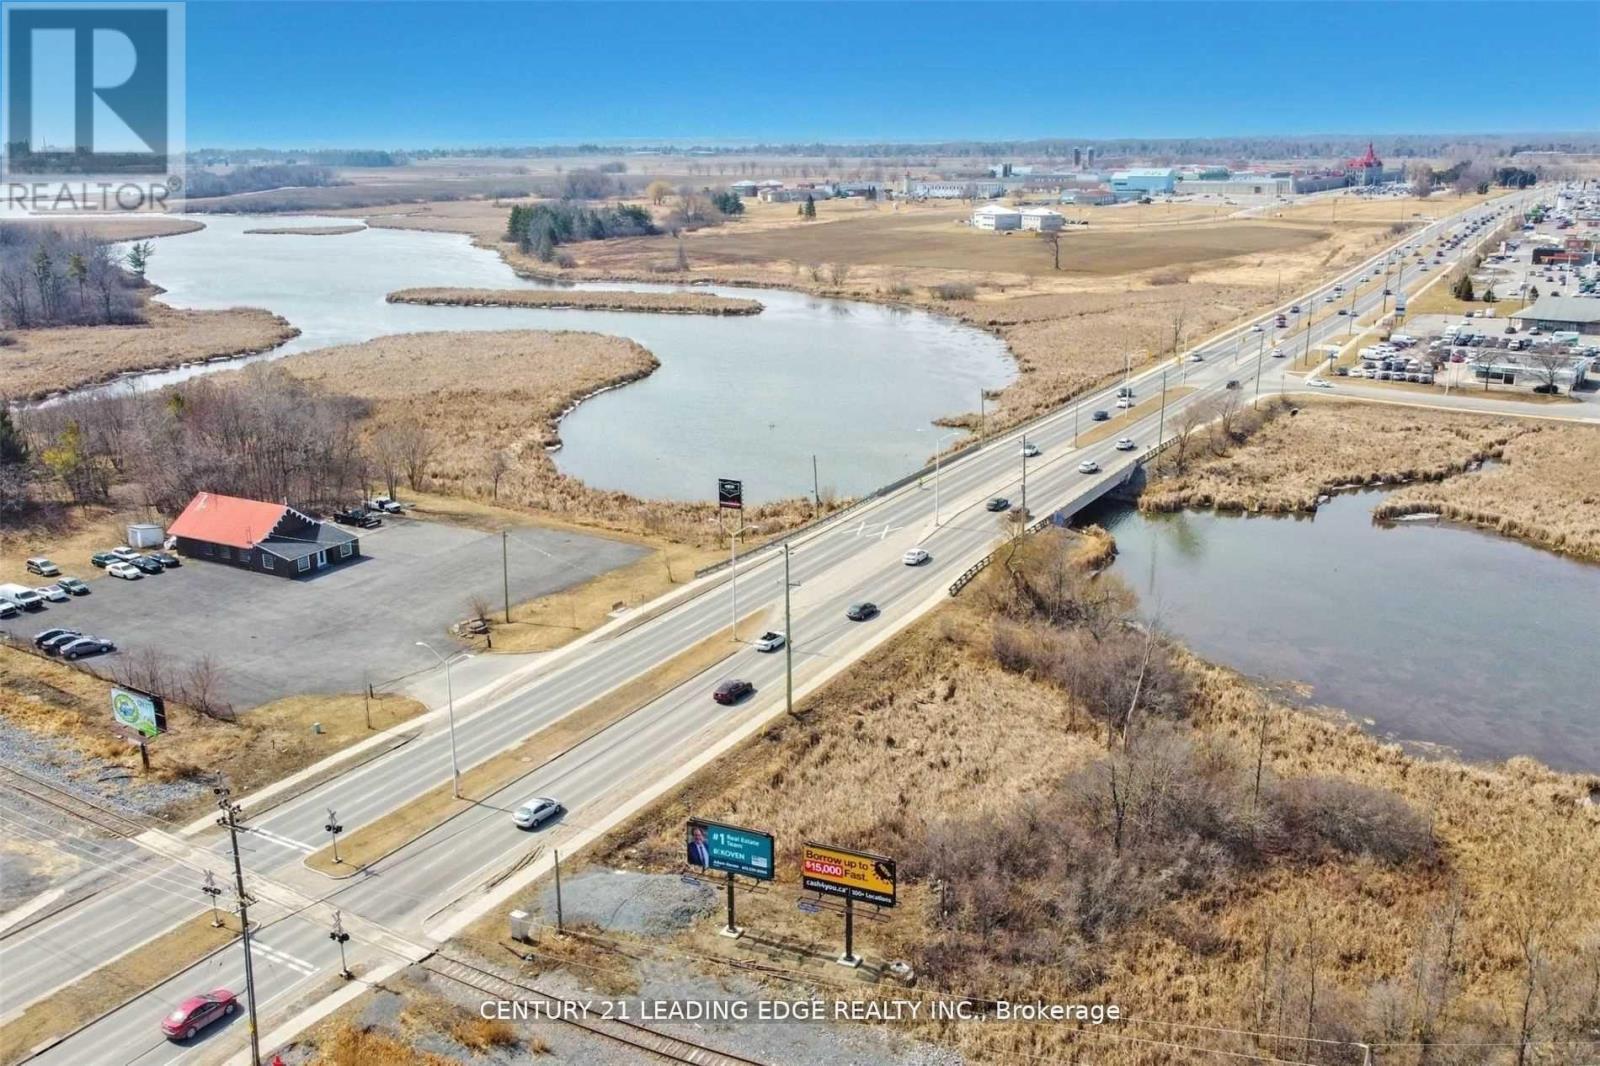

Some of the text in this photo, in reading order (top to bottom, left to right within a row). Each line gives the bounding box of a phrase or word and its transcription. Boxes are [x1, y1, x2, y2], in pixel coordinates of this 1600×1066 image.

[712, 832, 726, 846] #1
[805, 860, 842, 876] $15,000
[806, 850, 842, 865] Borrow
[844, 859, 857, 869] up
[858, 861, 869, 871] to
